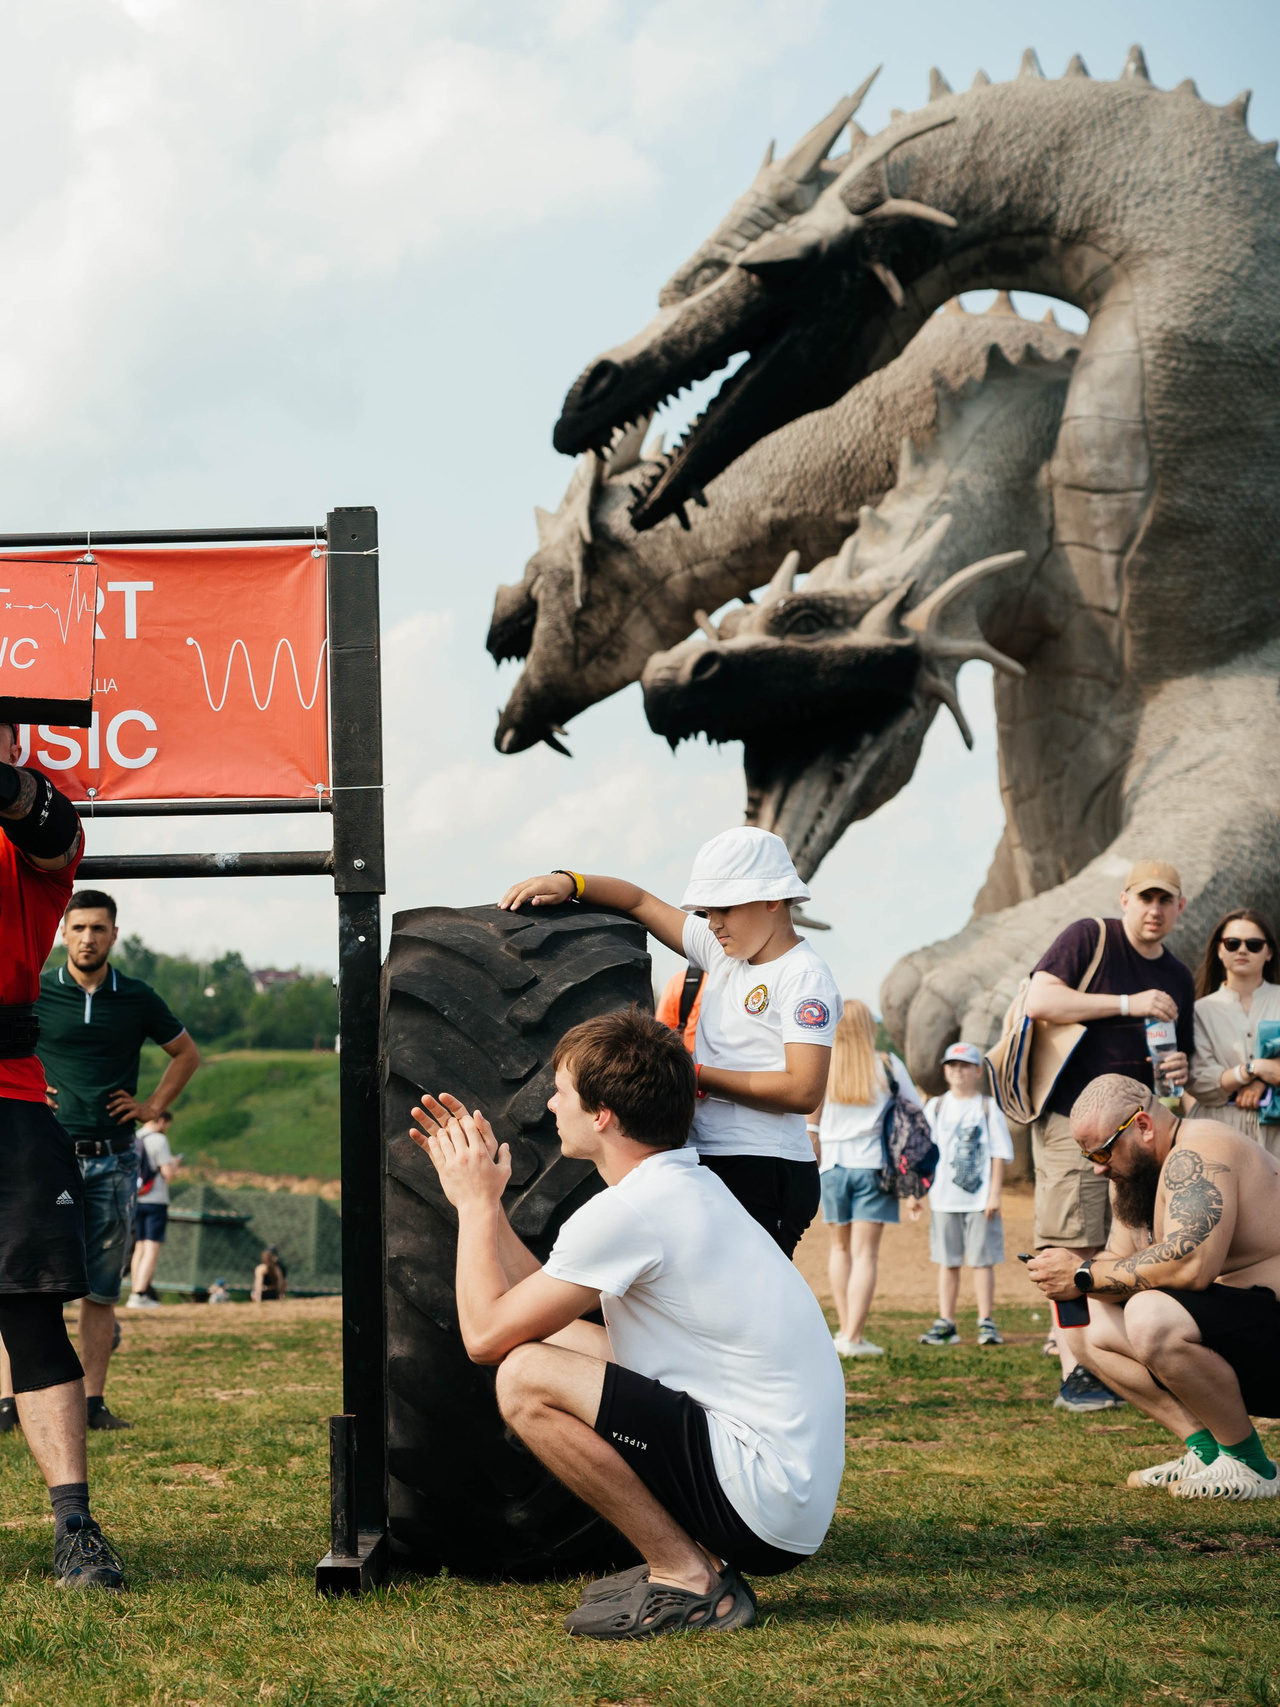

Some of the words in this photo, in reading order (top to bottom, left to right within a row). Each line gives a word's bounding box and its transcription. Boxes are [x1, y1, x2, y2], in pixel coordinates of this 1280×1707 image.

[94, 581, 154, 640] T
[93, 678, 118, 695] ЦА
[612, 1431, 648, 1451] KIPSTA
